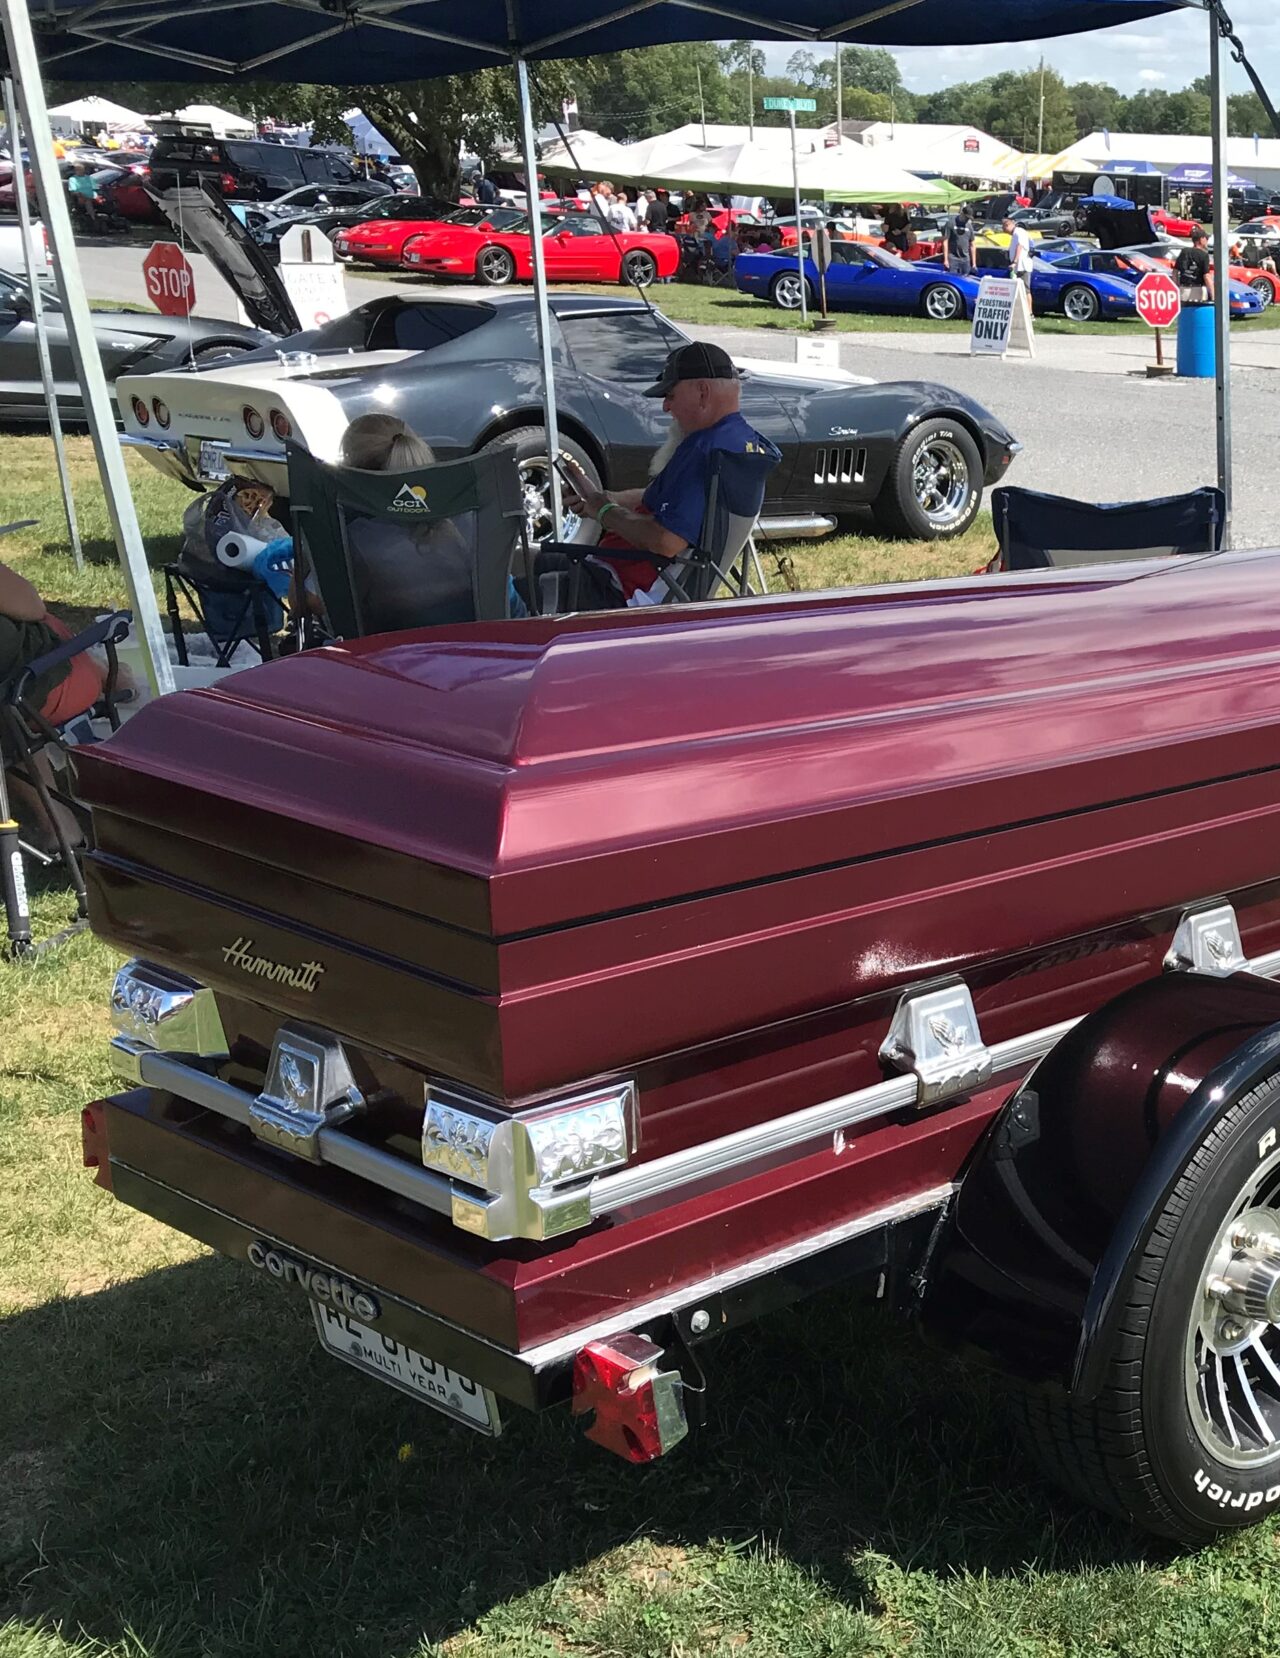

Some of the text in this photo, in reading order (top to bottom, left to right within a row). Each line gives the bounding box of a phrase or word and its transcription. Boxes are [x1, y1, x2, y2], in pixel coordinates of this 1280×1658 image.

[148, 266, 191, 298] STOP
[979, 298, 1012, 308] PEDESTRIAN
[1140, 289, 1177, 310] STOP
[977, 307, 1010, 321] TRAFFIC
[974, 320, 1008, 341] ONLY
[912, 430, 953, 466] Radial T/A
[222, 937, 325, 993] Hammitt
[363, 1346, 447, 1398] MULTI YEAR
